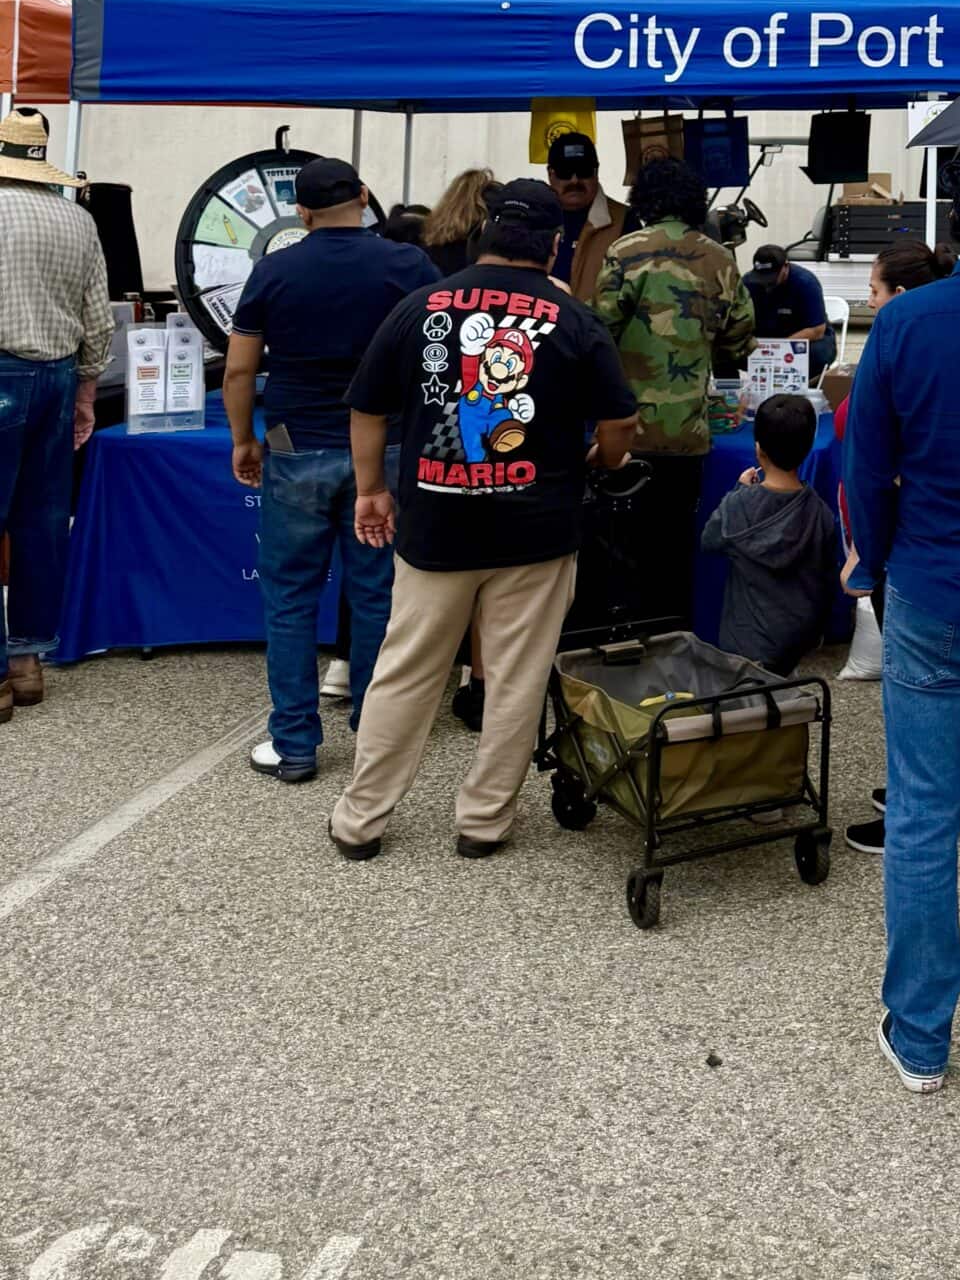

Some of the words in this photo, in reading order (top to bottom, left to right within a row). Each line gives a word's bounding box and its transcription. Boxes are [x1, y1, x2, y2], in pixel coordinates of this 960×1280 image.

[573, 11, 700, 83] City
[723, 11, 788, 69] of
[810, 11, 943, 69] Port
[426, 288, 560, 322] SUPER
[417, 456, 537, 487] MARIO
